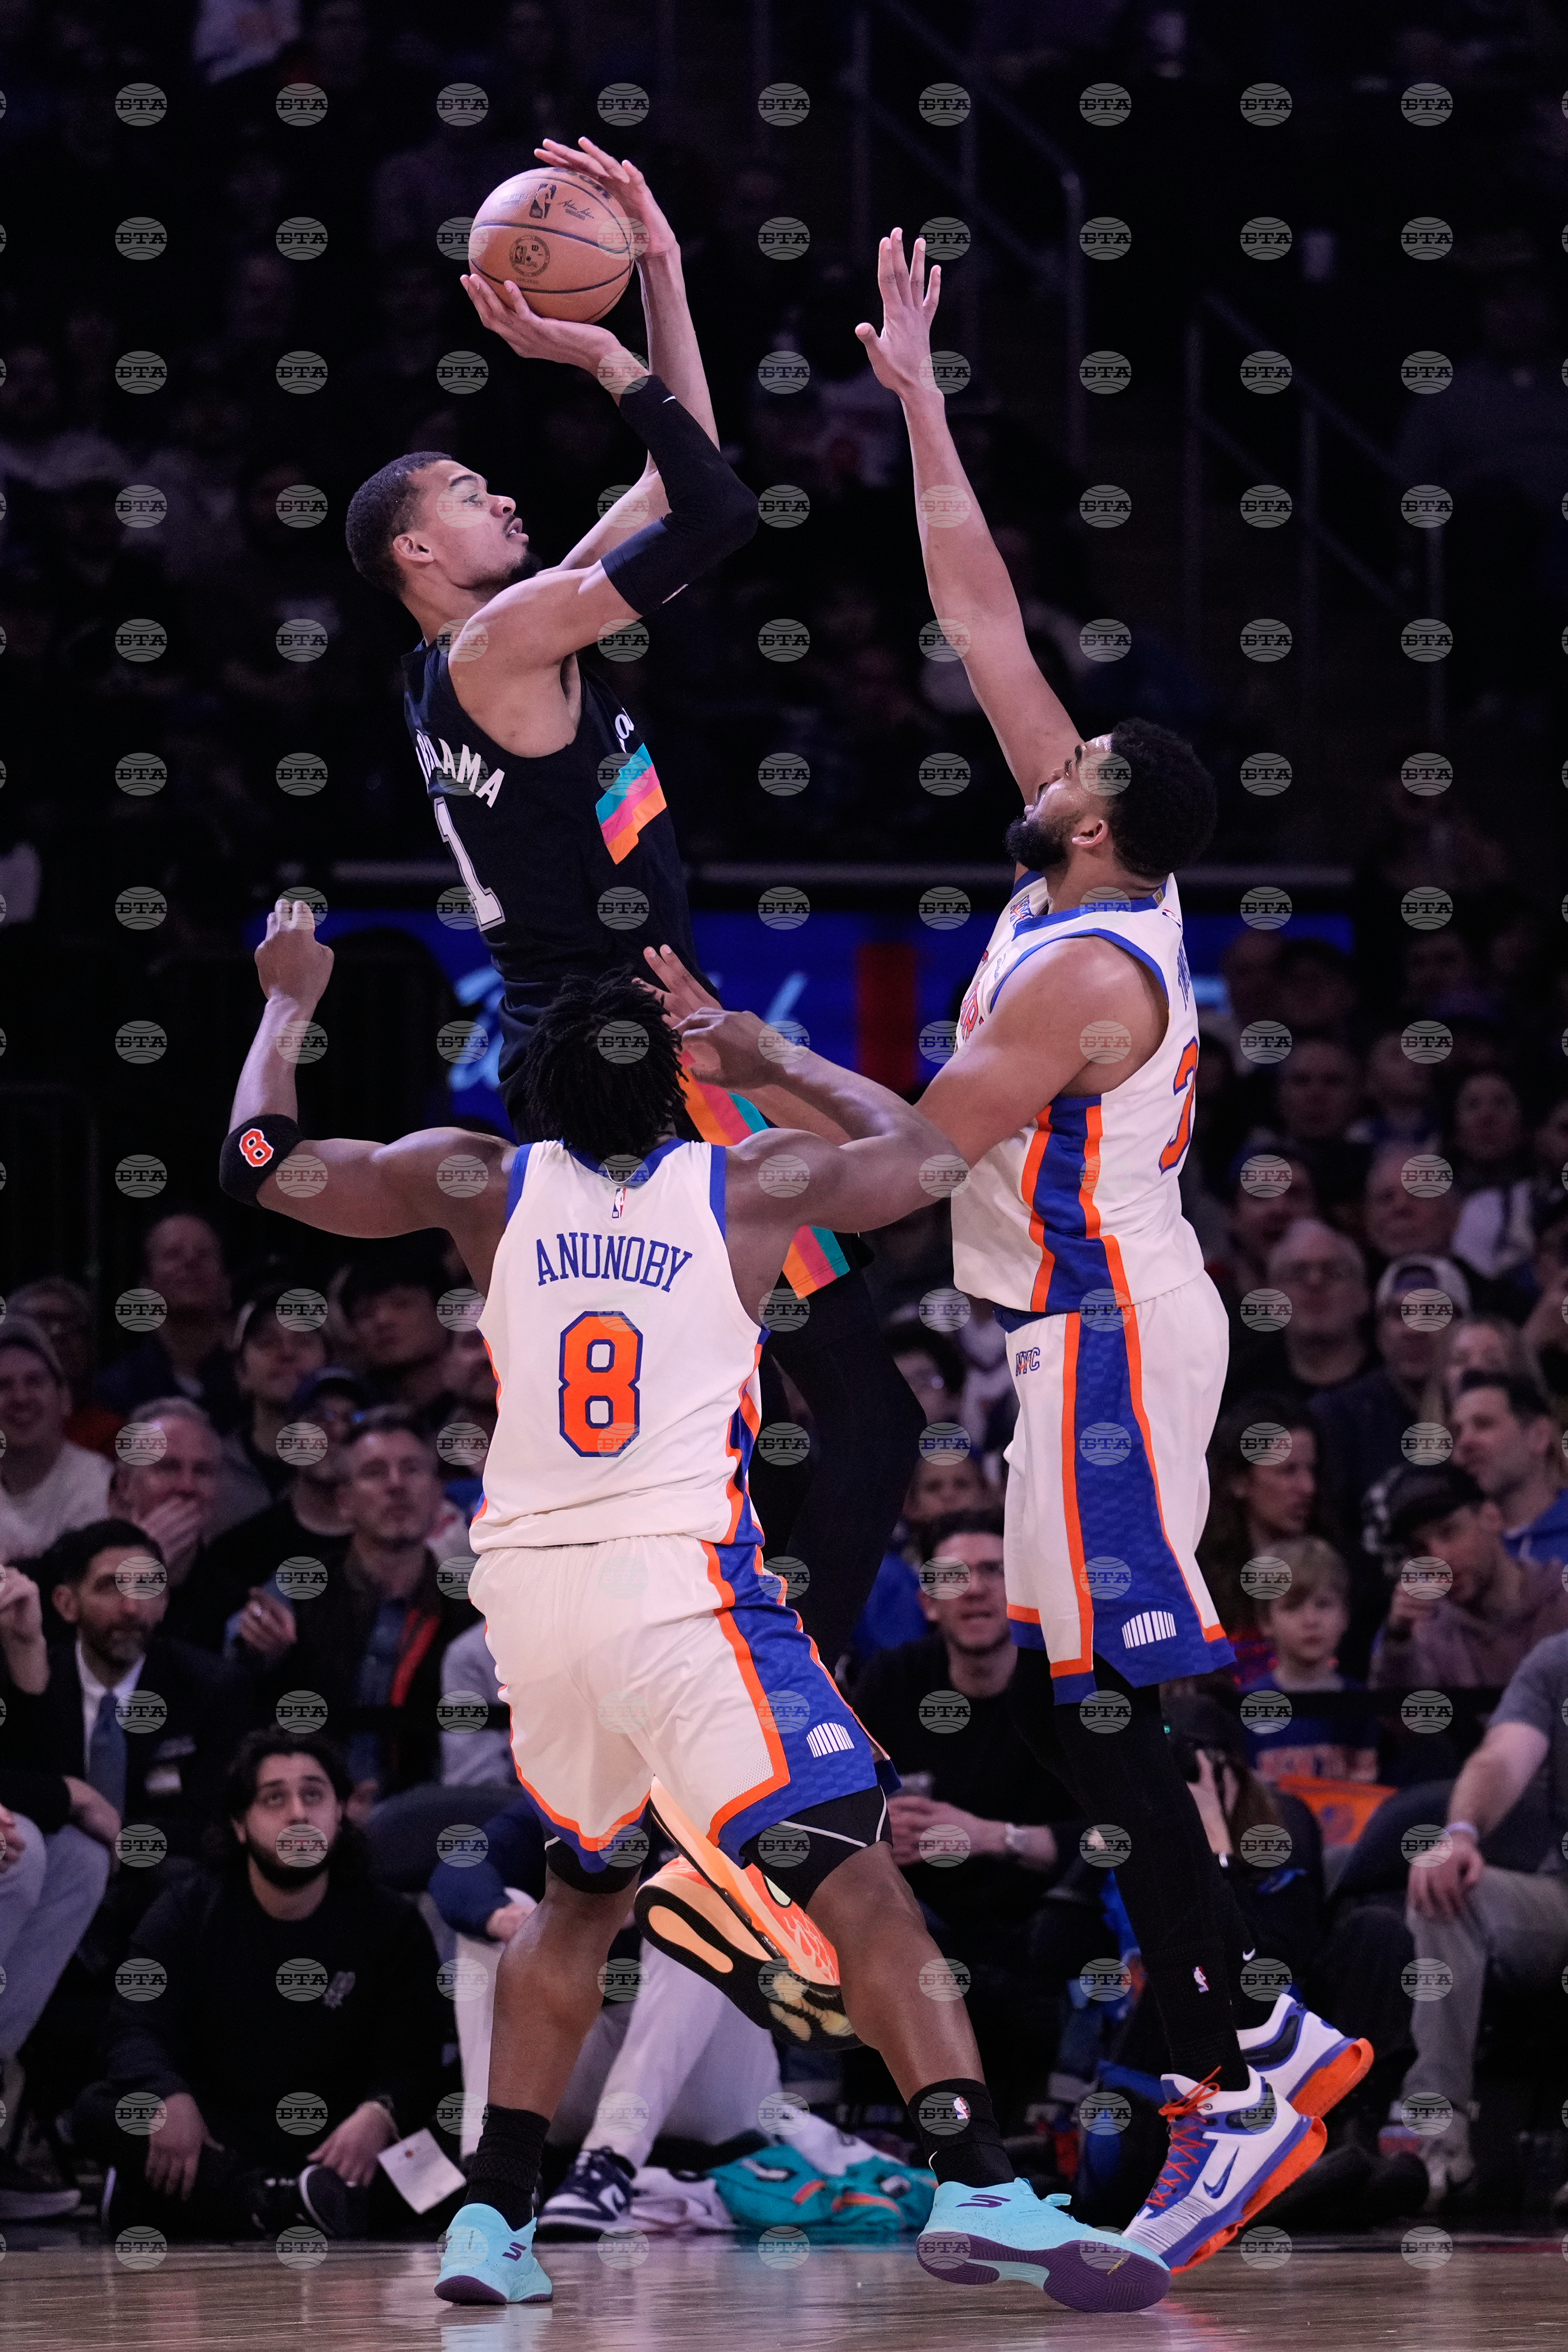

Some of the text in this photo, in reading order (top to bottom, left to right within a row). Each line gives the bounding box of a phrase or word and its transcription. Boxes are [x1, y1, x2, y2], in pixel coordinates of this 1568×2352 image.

[434, 796, 505, 932] 1
[239, 1128, 274, 1167] 8
[536, 1232, 692, 1293] ANUNOBY
[559, 1311, 643, 1457] 8
[1016, 1347, 1040, 1376] NYC
